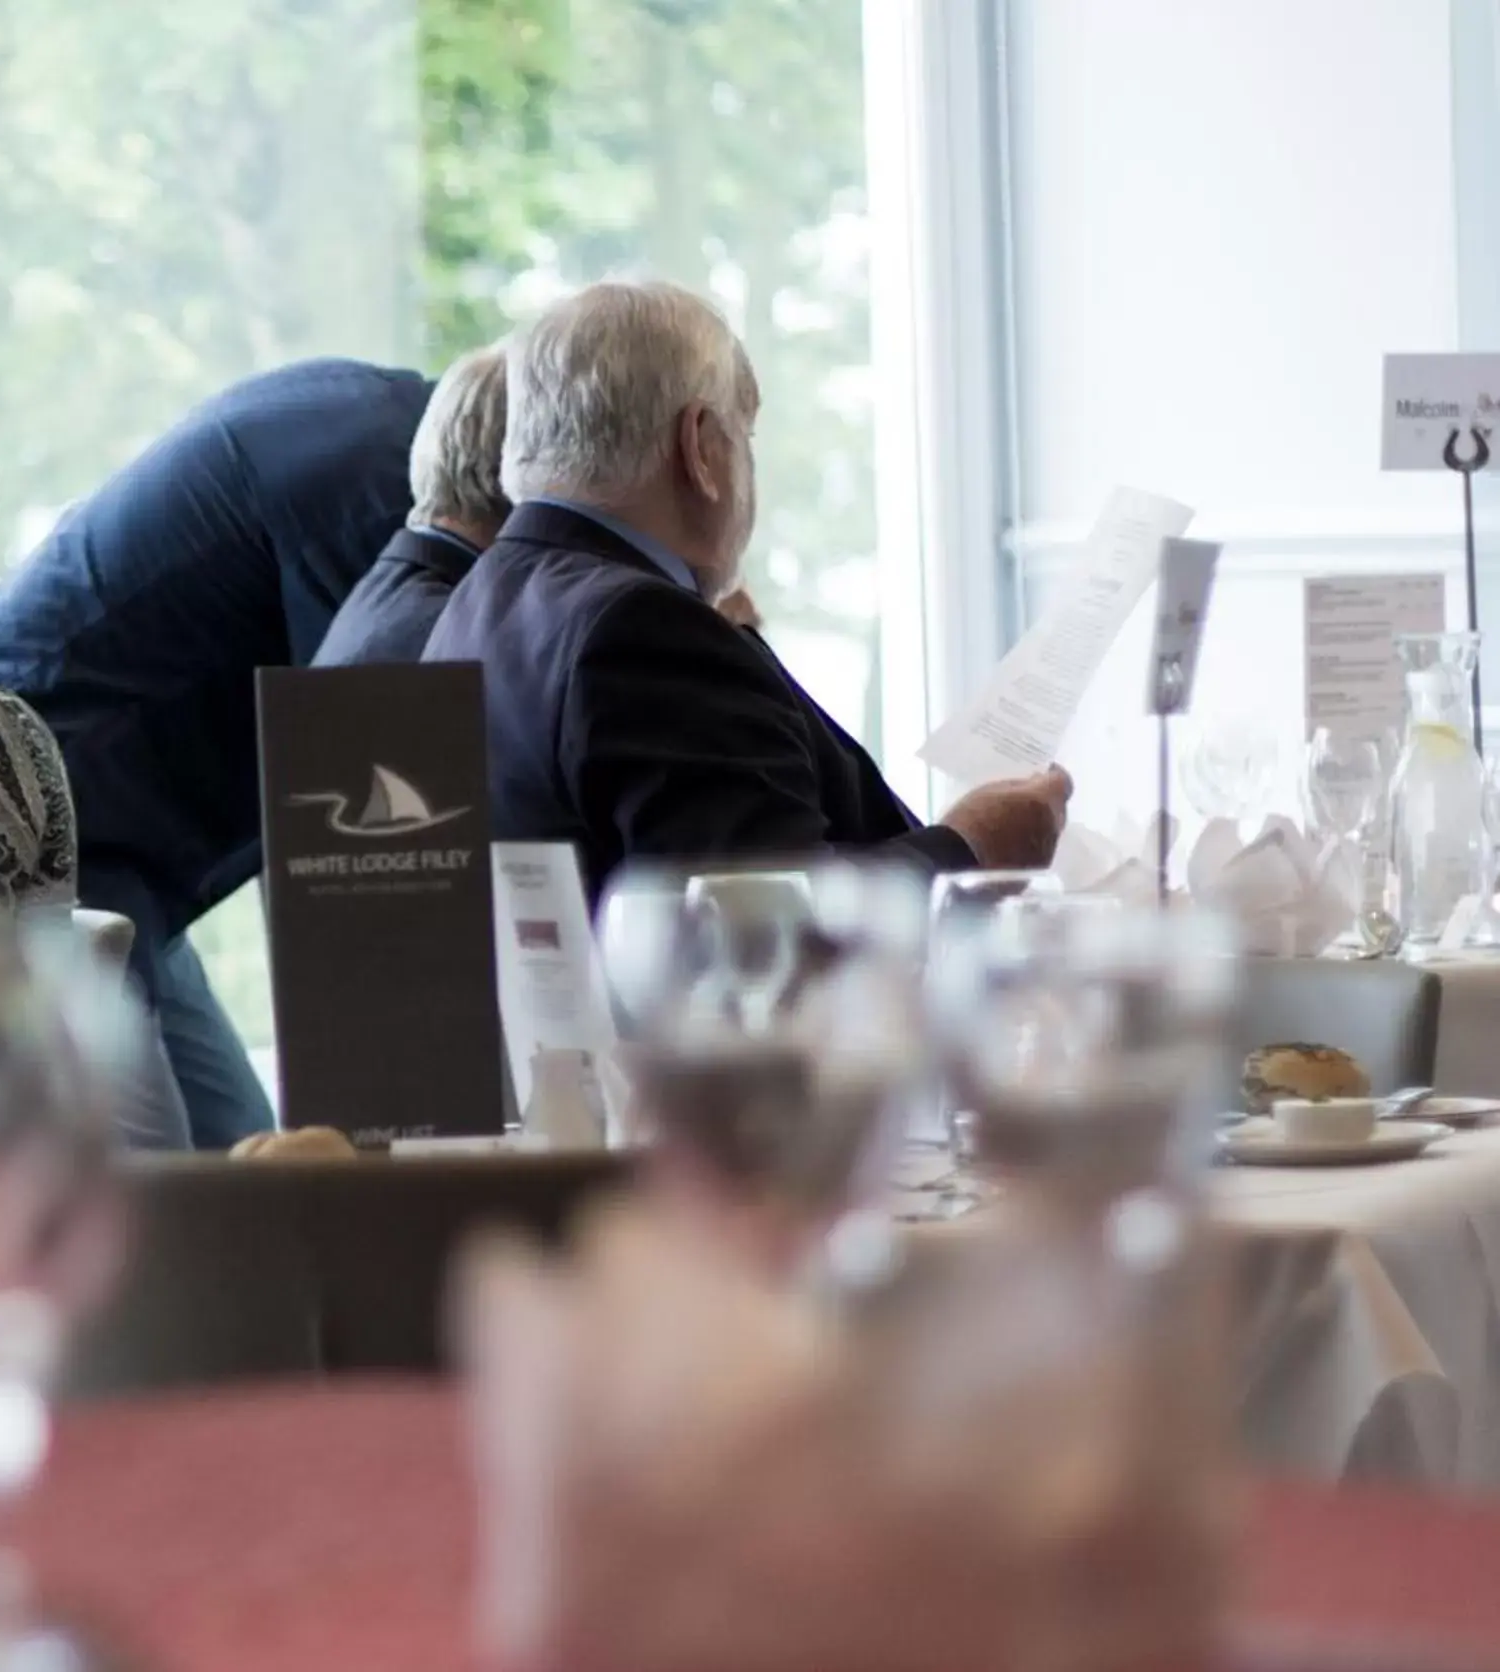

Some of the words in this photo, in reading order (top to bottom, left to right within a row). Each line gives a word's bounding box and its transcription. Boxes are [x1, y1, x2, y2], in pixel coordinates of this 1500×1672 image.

[286, 854, 349, 878] WHITE
[352, 851, 417, 875] LODGE
[420, 847, 472, 871] FILEY
